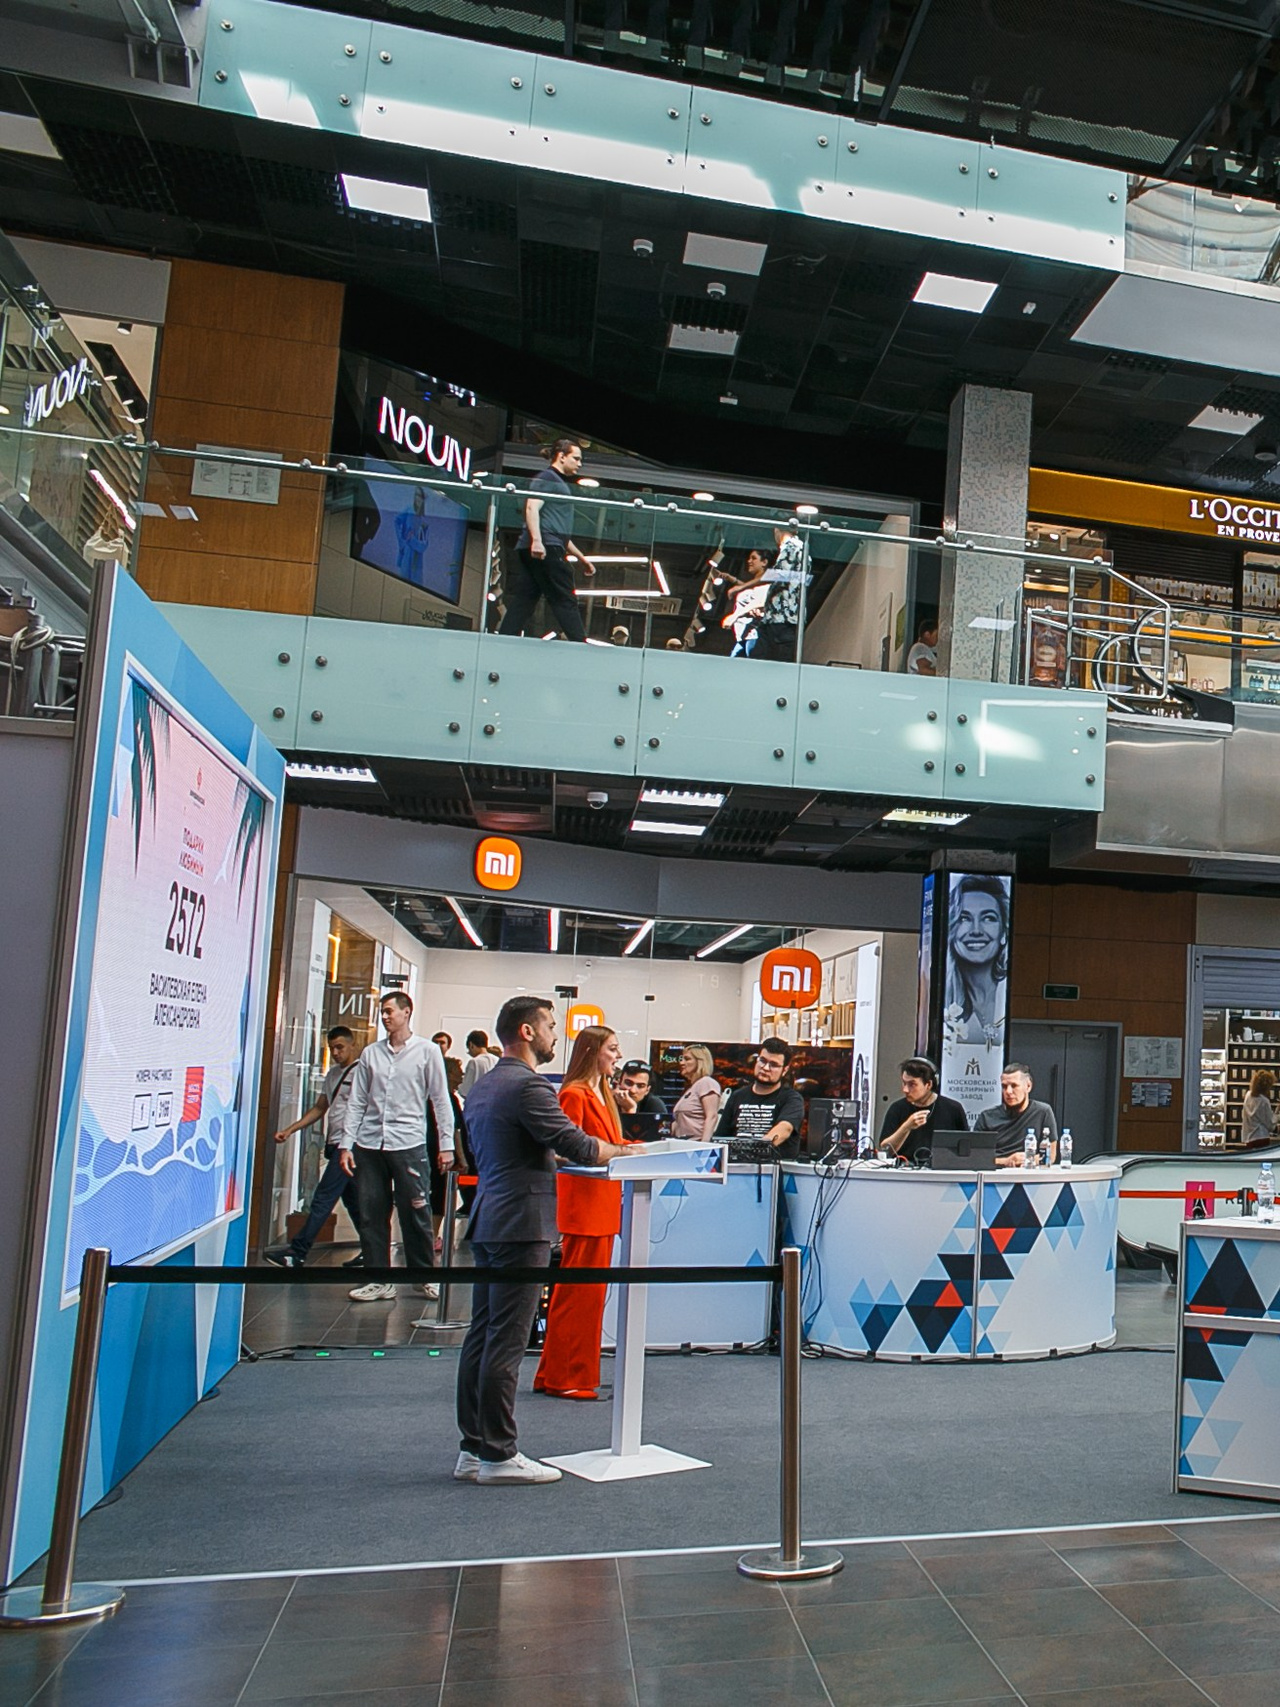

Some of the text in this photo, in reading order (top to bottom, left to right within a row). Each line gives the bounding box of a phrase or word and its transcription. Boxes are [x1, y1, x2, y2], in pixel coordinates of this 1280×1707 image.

[379, 396, 471, 481] NOUN
[1217, 525, 1235, 536] EN
[165, 881, 206, 959] 2572
